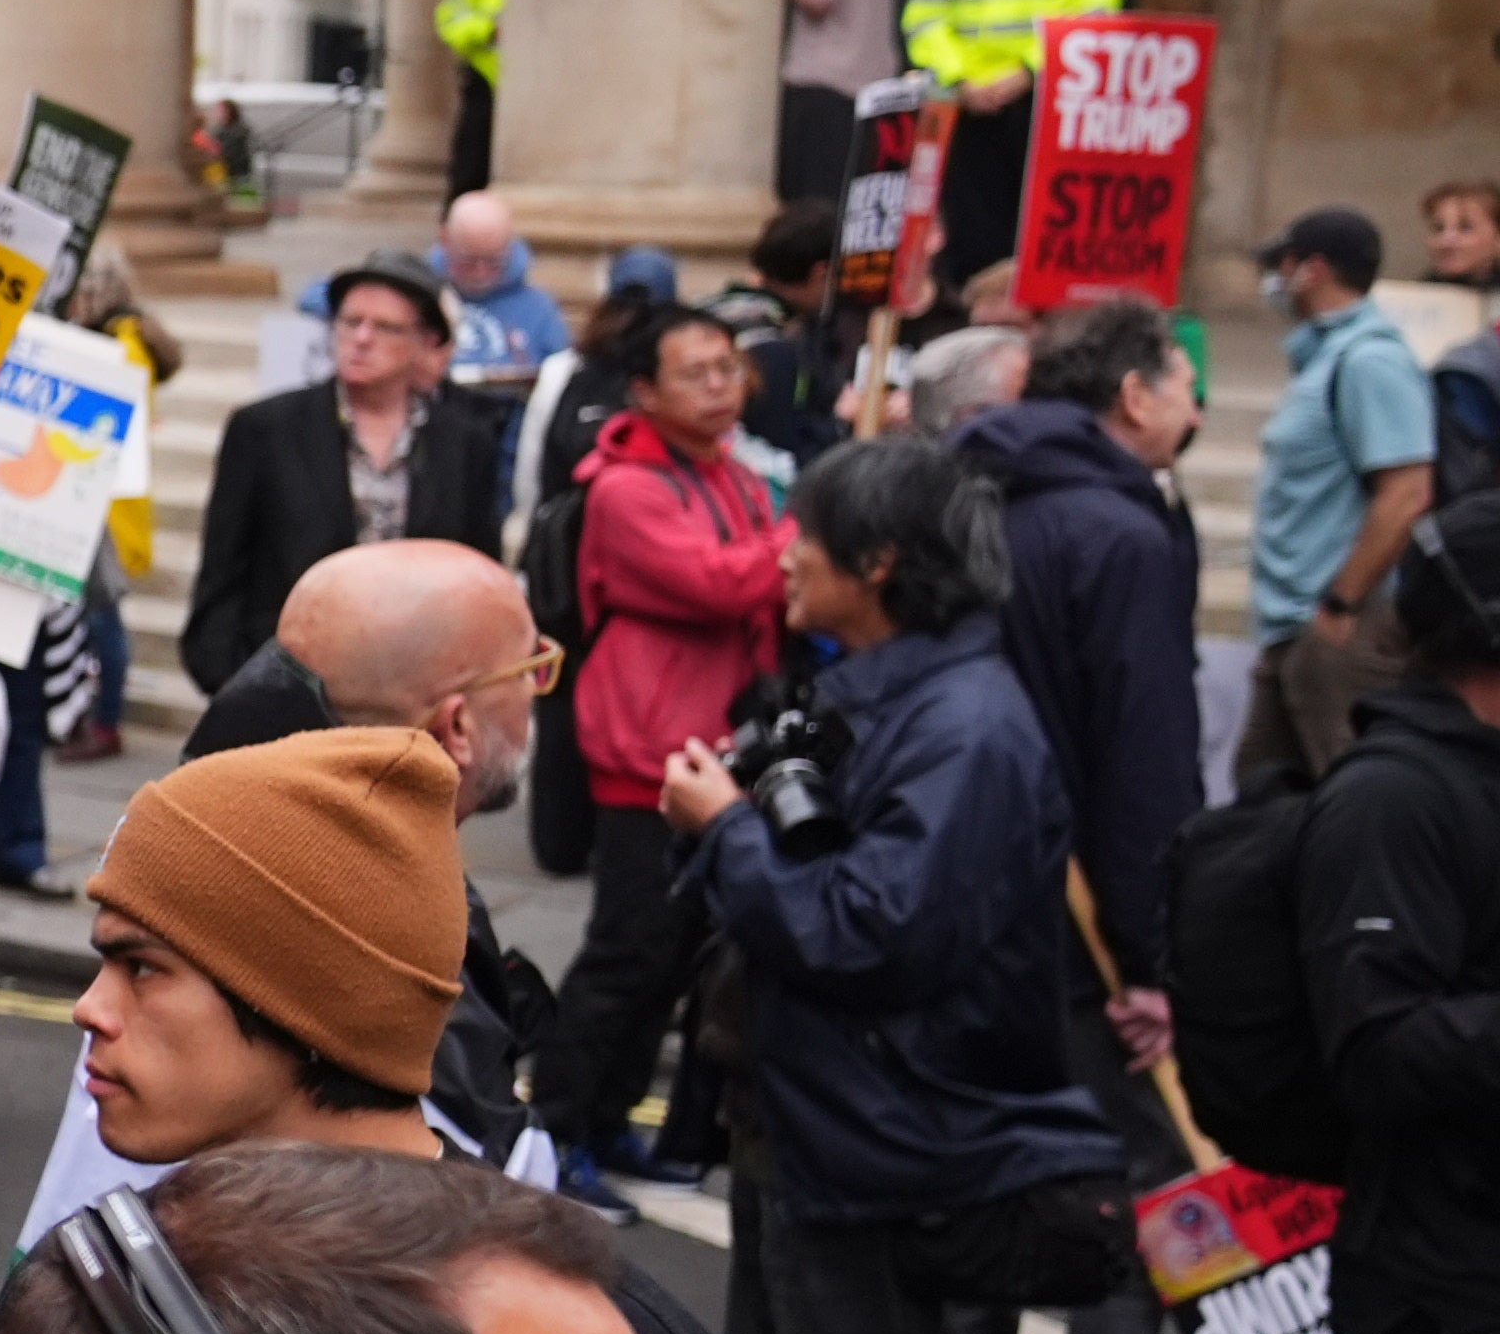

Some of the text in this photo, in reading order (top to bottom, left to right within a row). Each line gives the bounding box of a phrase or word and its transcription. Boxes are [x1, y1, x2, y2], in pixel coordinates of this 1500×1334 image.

[1059, 28, 1199, 99] STOP
[1055, 94, 1190, 155] TRUMP
[1046, 171, 1172, 229] STOP
[1036, 233, 1166, 277] FASCISM
